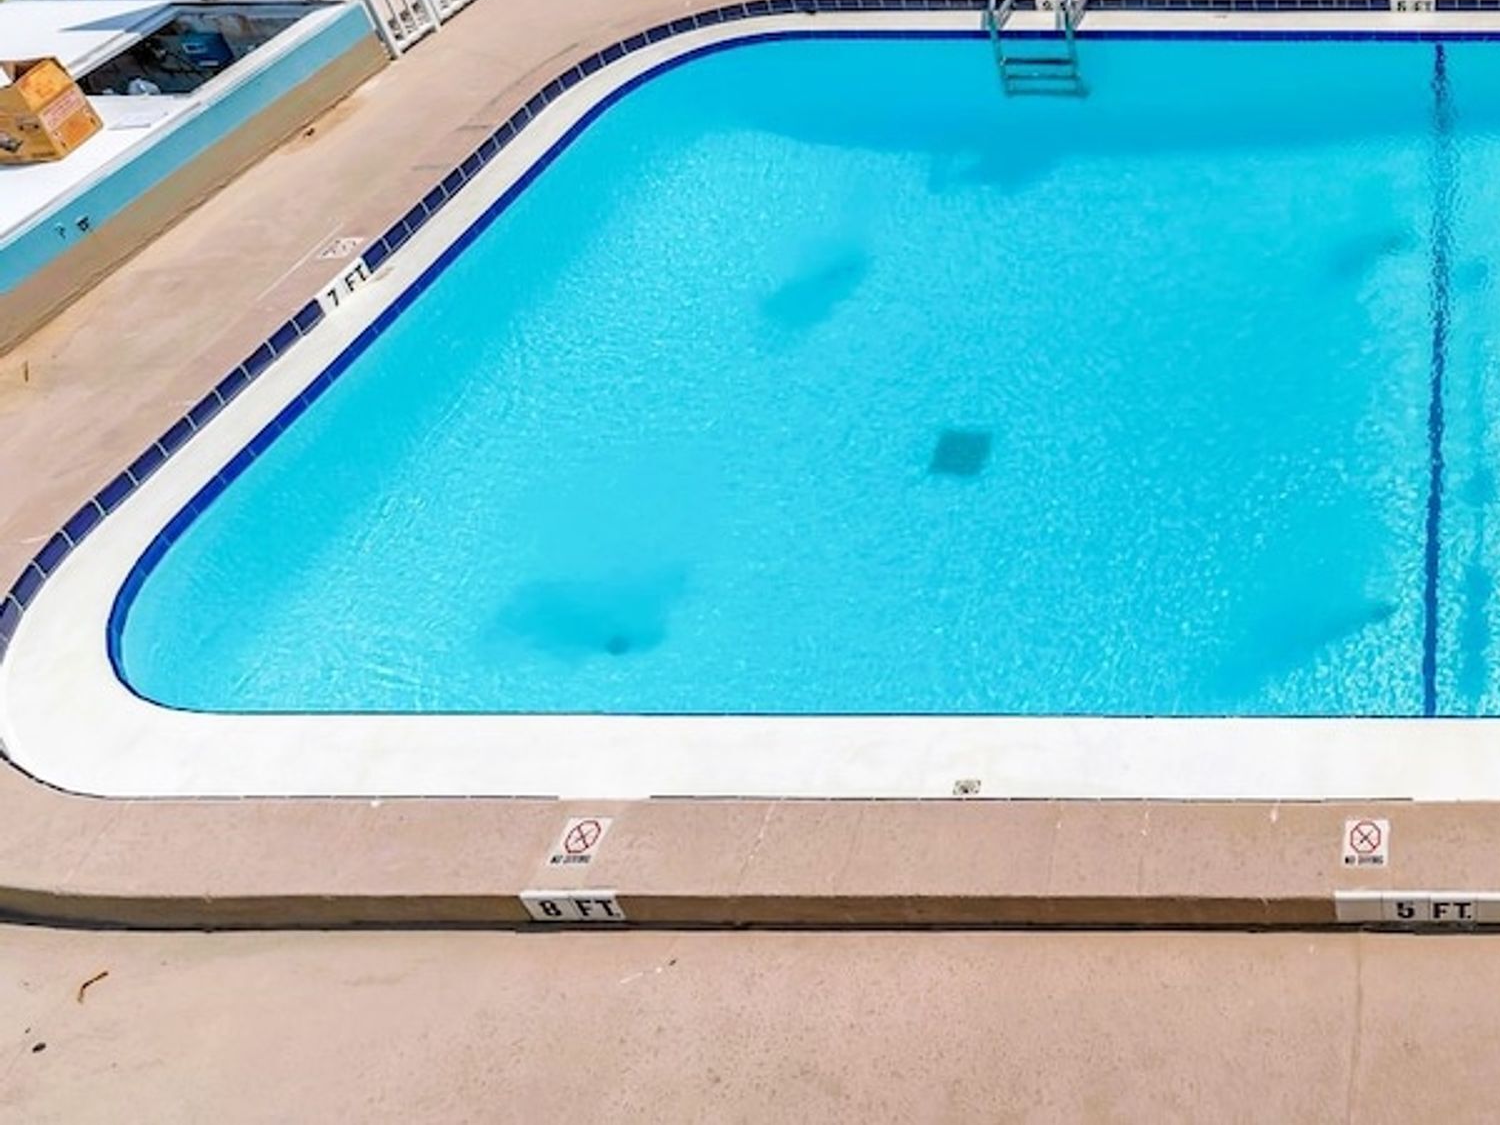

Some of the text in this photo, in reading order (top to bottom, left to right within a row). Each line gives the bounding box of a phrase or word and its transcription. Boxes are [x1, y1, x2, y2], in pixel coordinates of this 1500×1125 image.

[327, 287, 339, 307] 7
[539, 900, 562, 917] 8
[1396, 902, 1472, 920] 5 FT.
